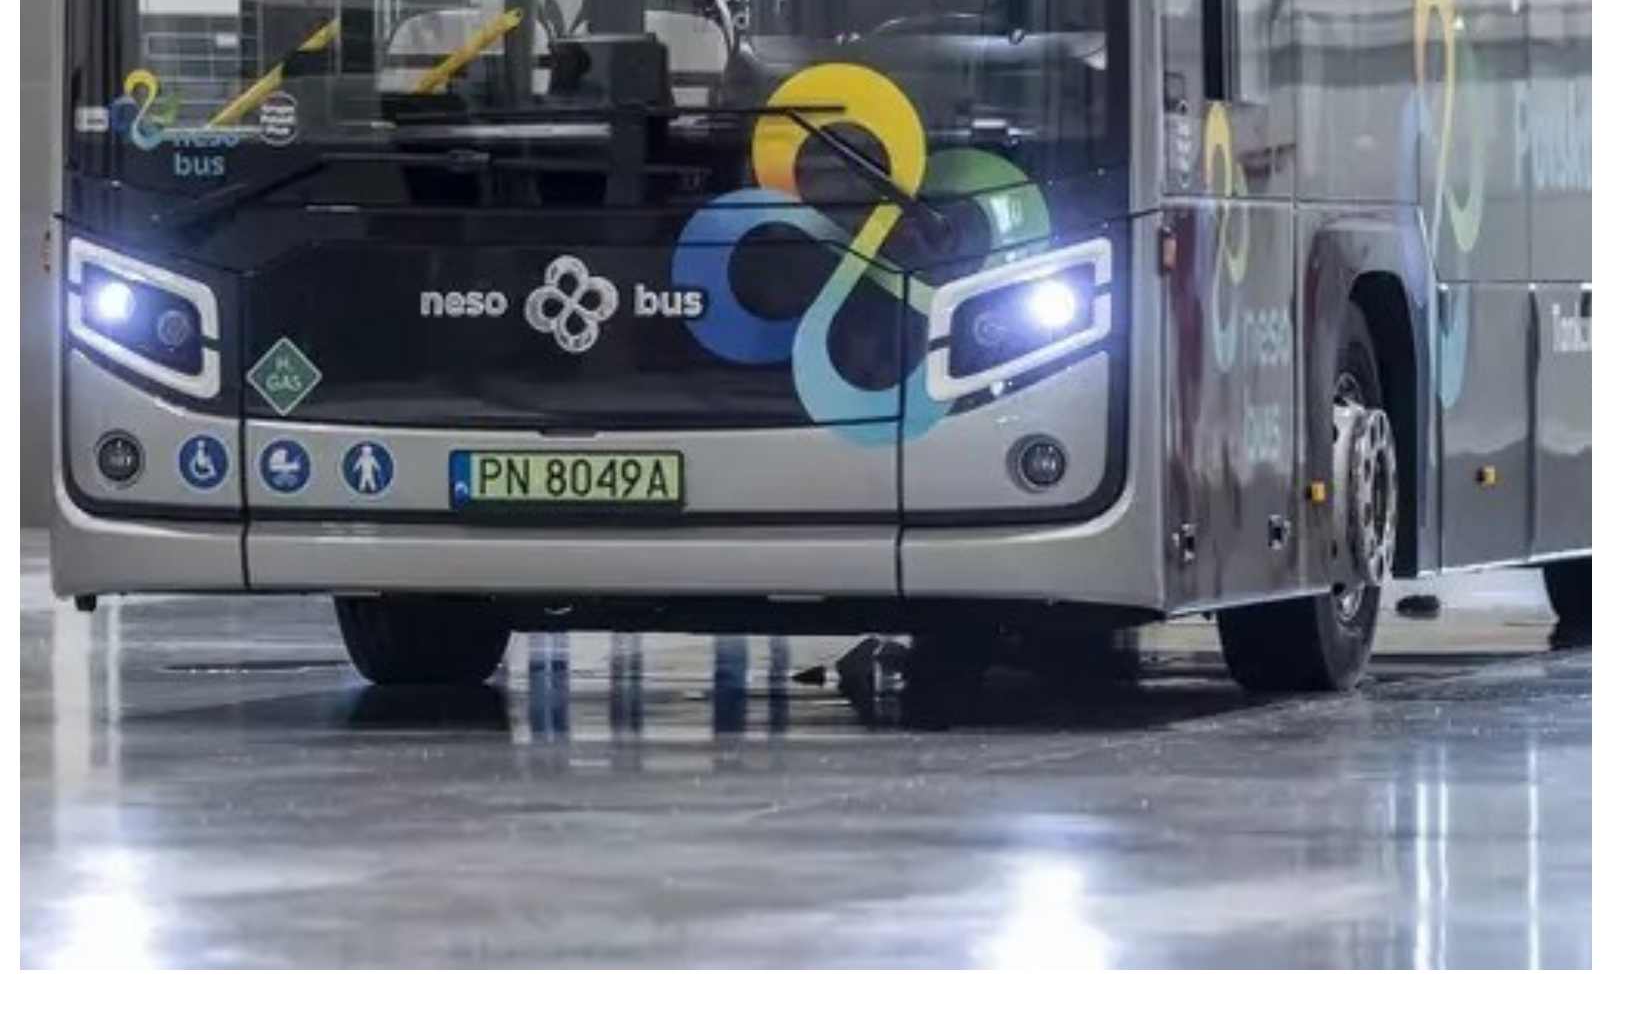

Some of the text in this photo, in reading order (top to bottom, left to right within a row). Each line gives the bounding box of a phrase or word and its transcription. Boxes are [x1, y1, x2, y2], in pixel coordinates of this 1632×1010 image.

[175, 153, 225, 176] bus
[420, 284, 703, 316] neso bus
[266, 375, 302, 391] GAS
[479, 457, 668, 497] PN 8049A
